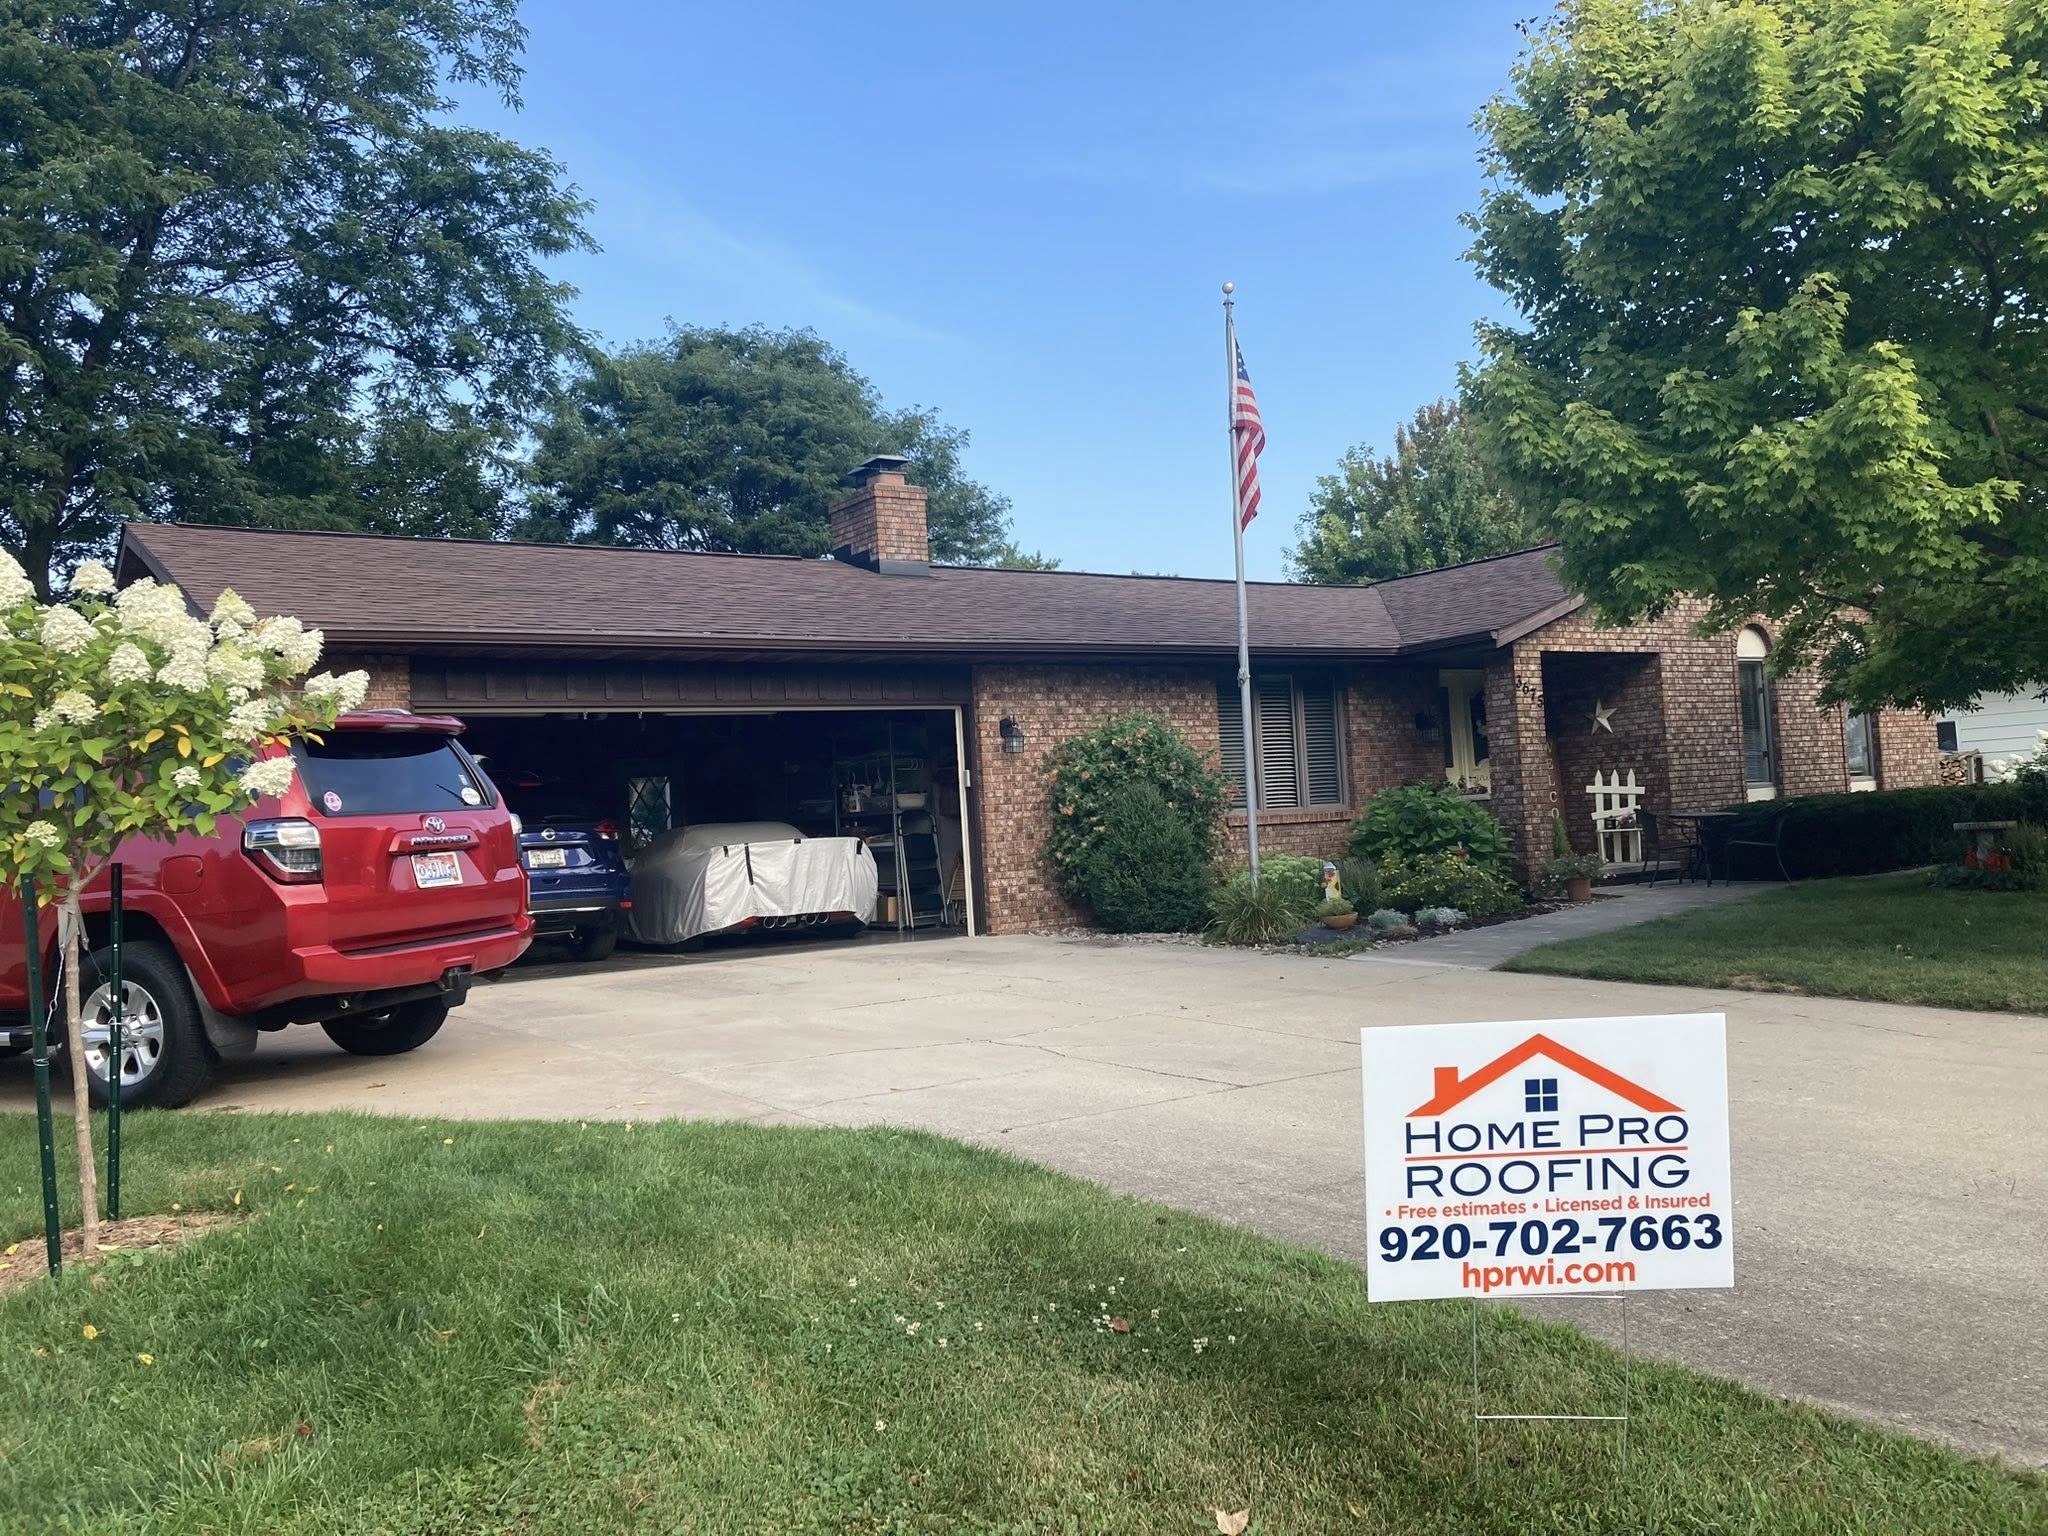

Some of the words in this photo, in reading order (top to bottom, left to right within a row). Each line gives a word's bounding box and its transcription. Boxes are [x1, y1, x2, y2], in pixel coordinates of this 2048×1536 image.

[1516, 675, 1543, 708] 3675
[1405, 1120, 1561, 1154] HOME
[1579, 1114, 1689, 1146] PRO
[1406, 1154, 1690, 1199] ROOFING
[1398, 1204, 1437, 1219] Free
[1442, 1200, 1527, 1217] estimates
[1545, 1194, 1623, 1213] Licensed
[1627, 1195, 1640, 1210] &
[1645, 1193, 1711, 1210] Insured
[1379, 1213, 1723, 1263] 920-702-7663
[1462, 1258, 1636, 1292] hprwi.com
